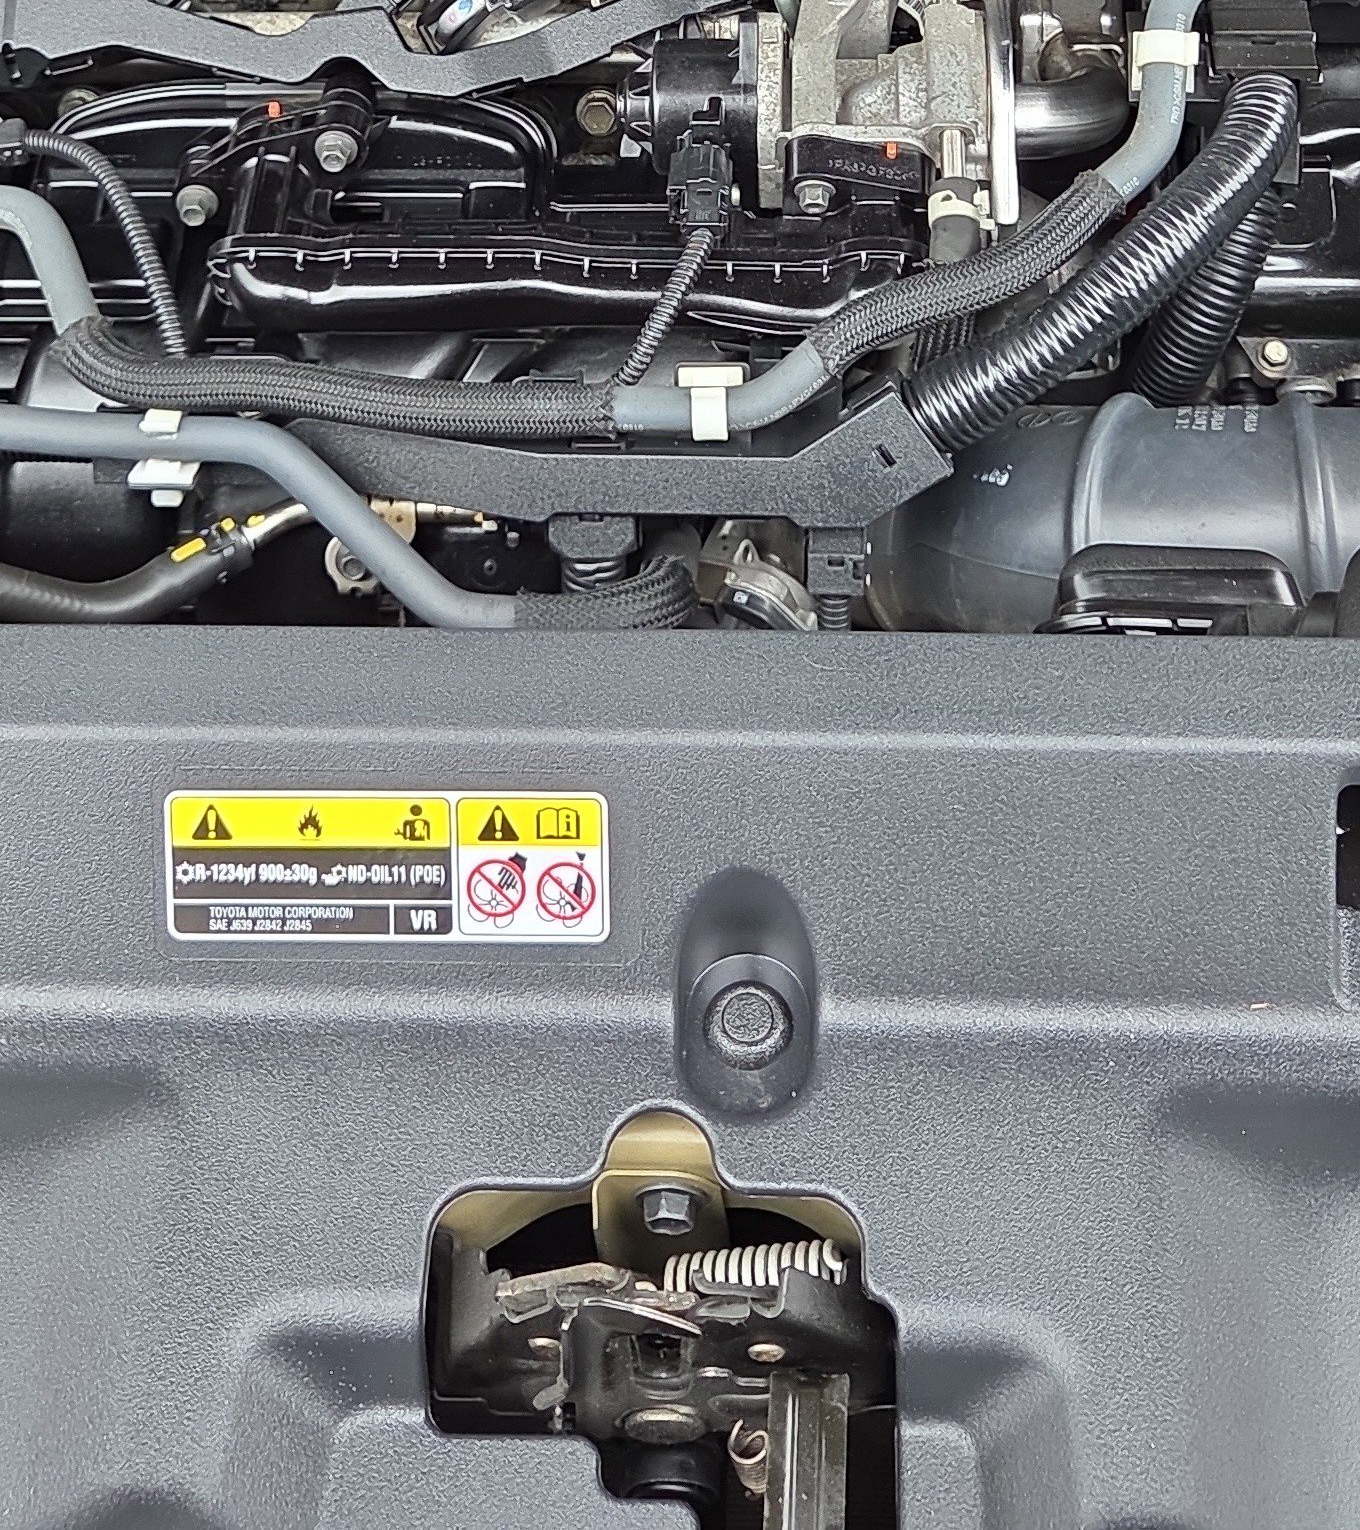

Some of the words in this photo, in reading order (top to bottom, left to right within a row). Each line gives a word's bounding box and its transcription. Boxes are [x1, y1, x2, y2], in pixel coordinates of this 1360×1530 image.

[195, 863, 256, 886] R-1234yf
[259, 864, 318, 886] 900±30g
[348, 864, 408, 885] ND-OIL11
[410, 864, 446, 887] (POE)
[209, 907, 247, 919] TOYOTA
[248, 907, 283, 919] MOTOR
[285, 907, 354, 919] CORPORATION
[410, 909, 439, 932] VR
[209, 919, 229, 931] SAE
[254, 919, 283, 931] J2842
[284, 919, 313, 931] J2845
